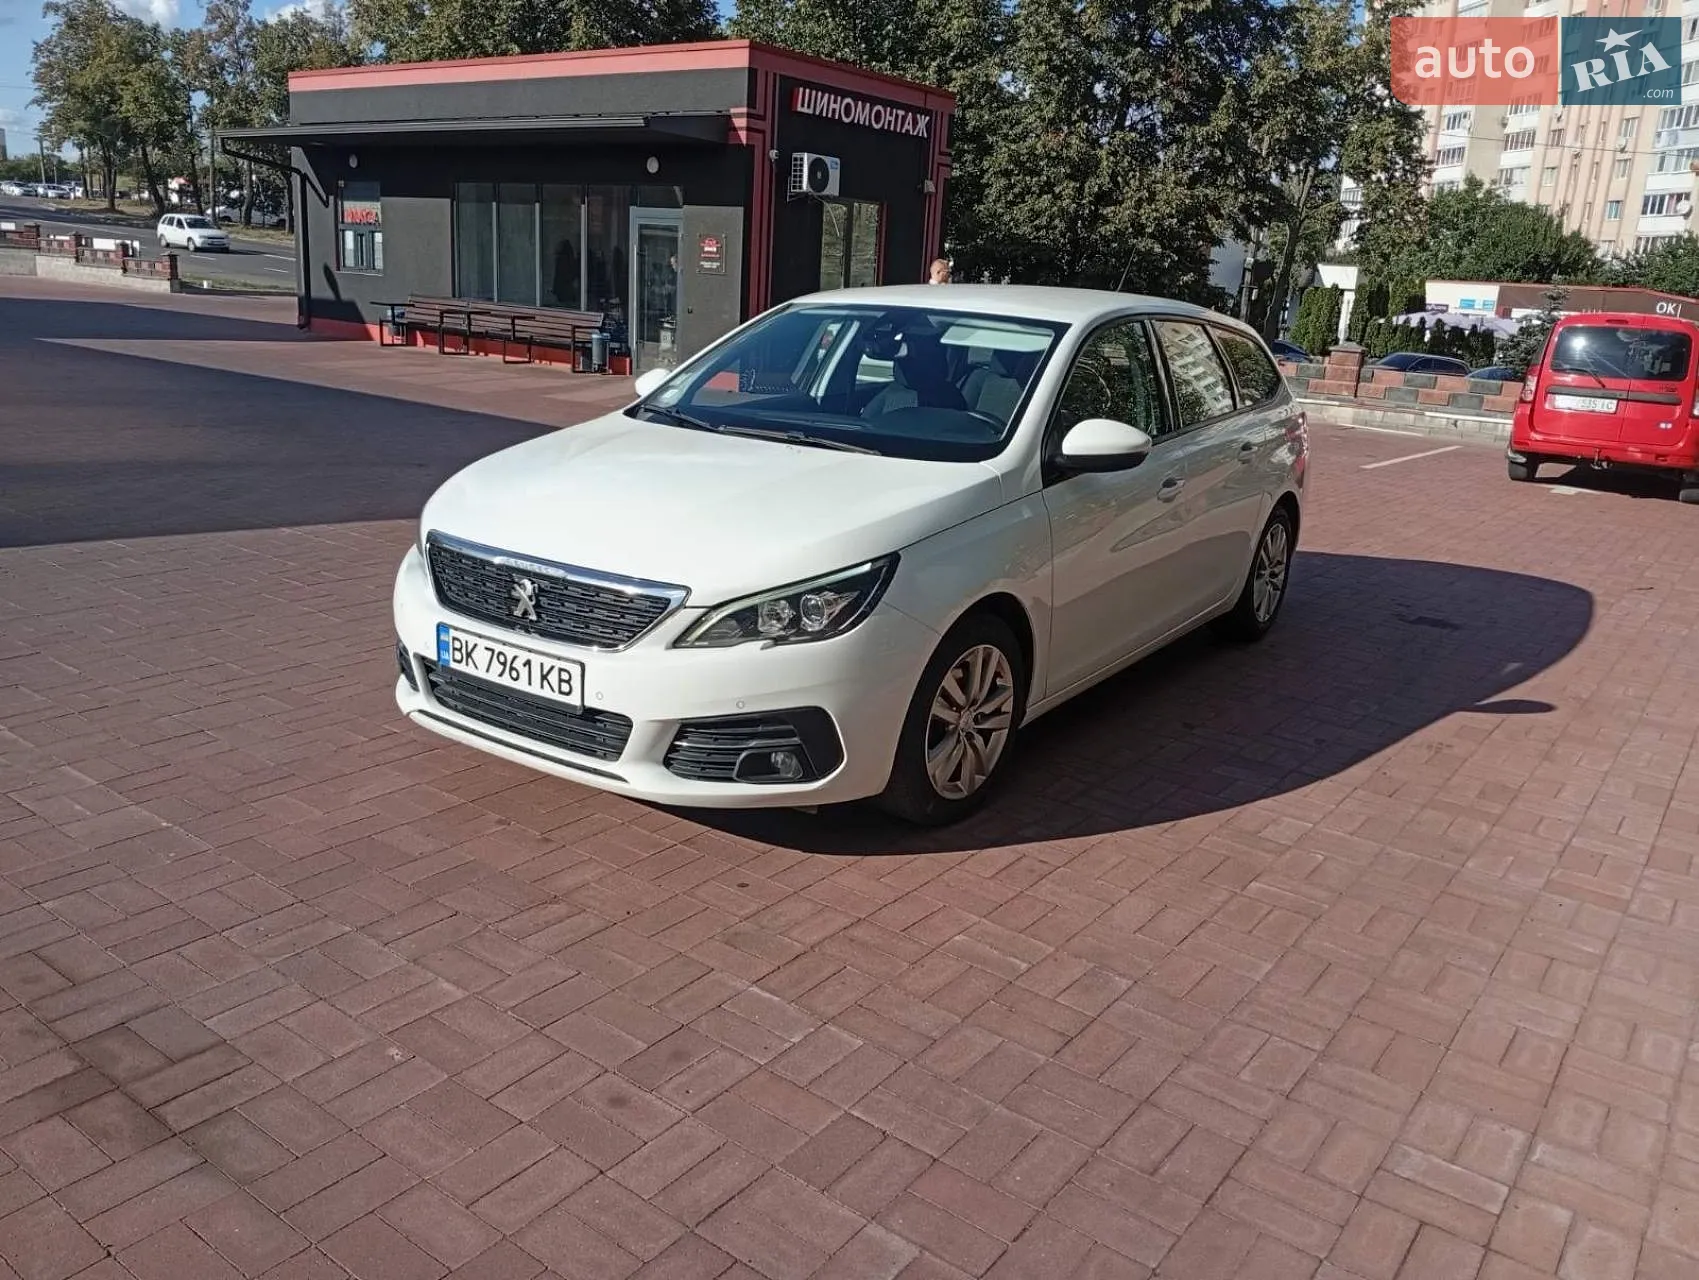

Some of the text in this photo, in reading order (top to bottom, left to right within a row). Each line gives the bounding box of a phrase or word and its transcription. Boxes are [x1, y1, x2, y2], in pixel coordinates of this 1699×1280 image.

[793, 86, 930, 138] ШИНОМОНТАЖ
[451, 636, 573, 697] BK 7961 KB
